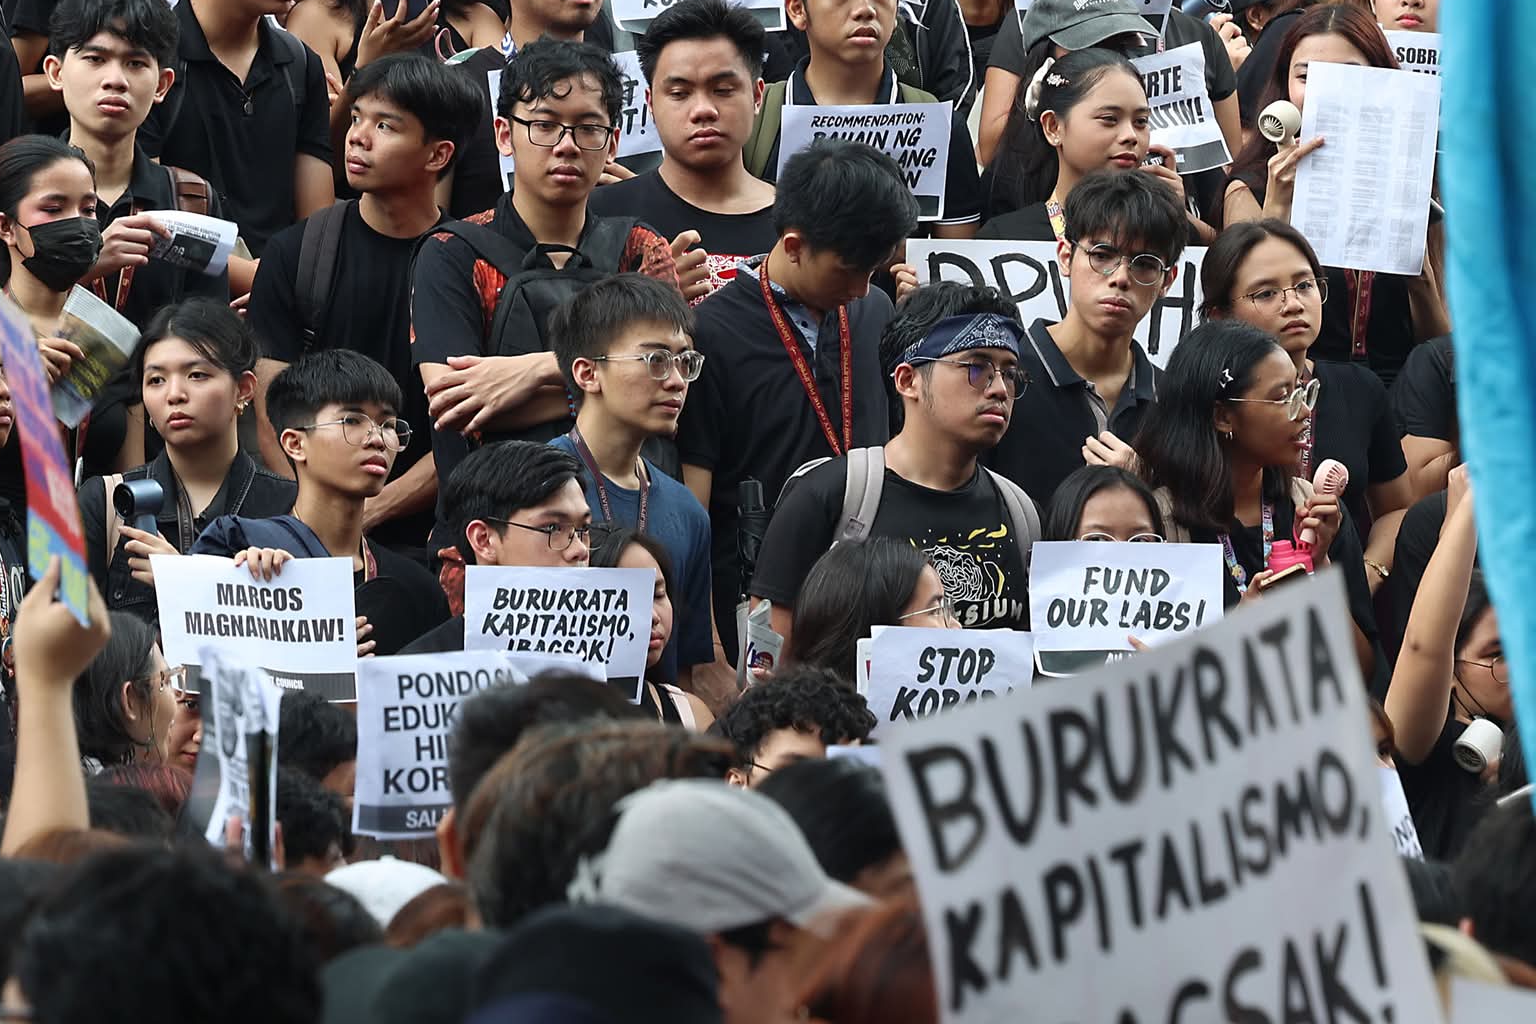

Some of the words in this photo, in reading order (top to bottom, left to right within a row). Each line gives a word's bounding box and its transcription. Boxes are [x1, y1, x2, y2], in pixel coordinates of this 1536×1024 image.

[1396, 46, 1441, 66] SOBR
[810, 112, 926, 129] RECOMMENDATION:
[893, 127, 923, 149] NG
[897, 147, 937, 169] ANG
[926, 250, 1197, 356] DPH
[1082, 566, 1171, 597] FUND
[216, 582, 304, 612] MARCOS
[492, 587, 629, 612] BURUKRATA
[184, 611, 345, 644] MAGNANAKAW!
[481, 612, 636, 642] KAPITALISMO,
[1046, 598, 1109, 629] OUR
[916, 645, 997, 686] STOP
[905, 604, 1351, 880] BURUKRATA
[944, 748, 1372, 1013] KAPITALISMO,
